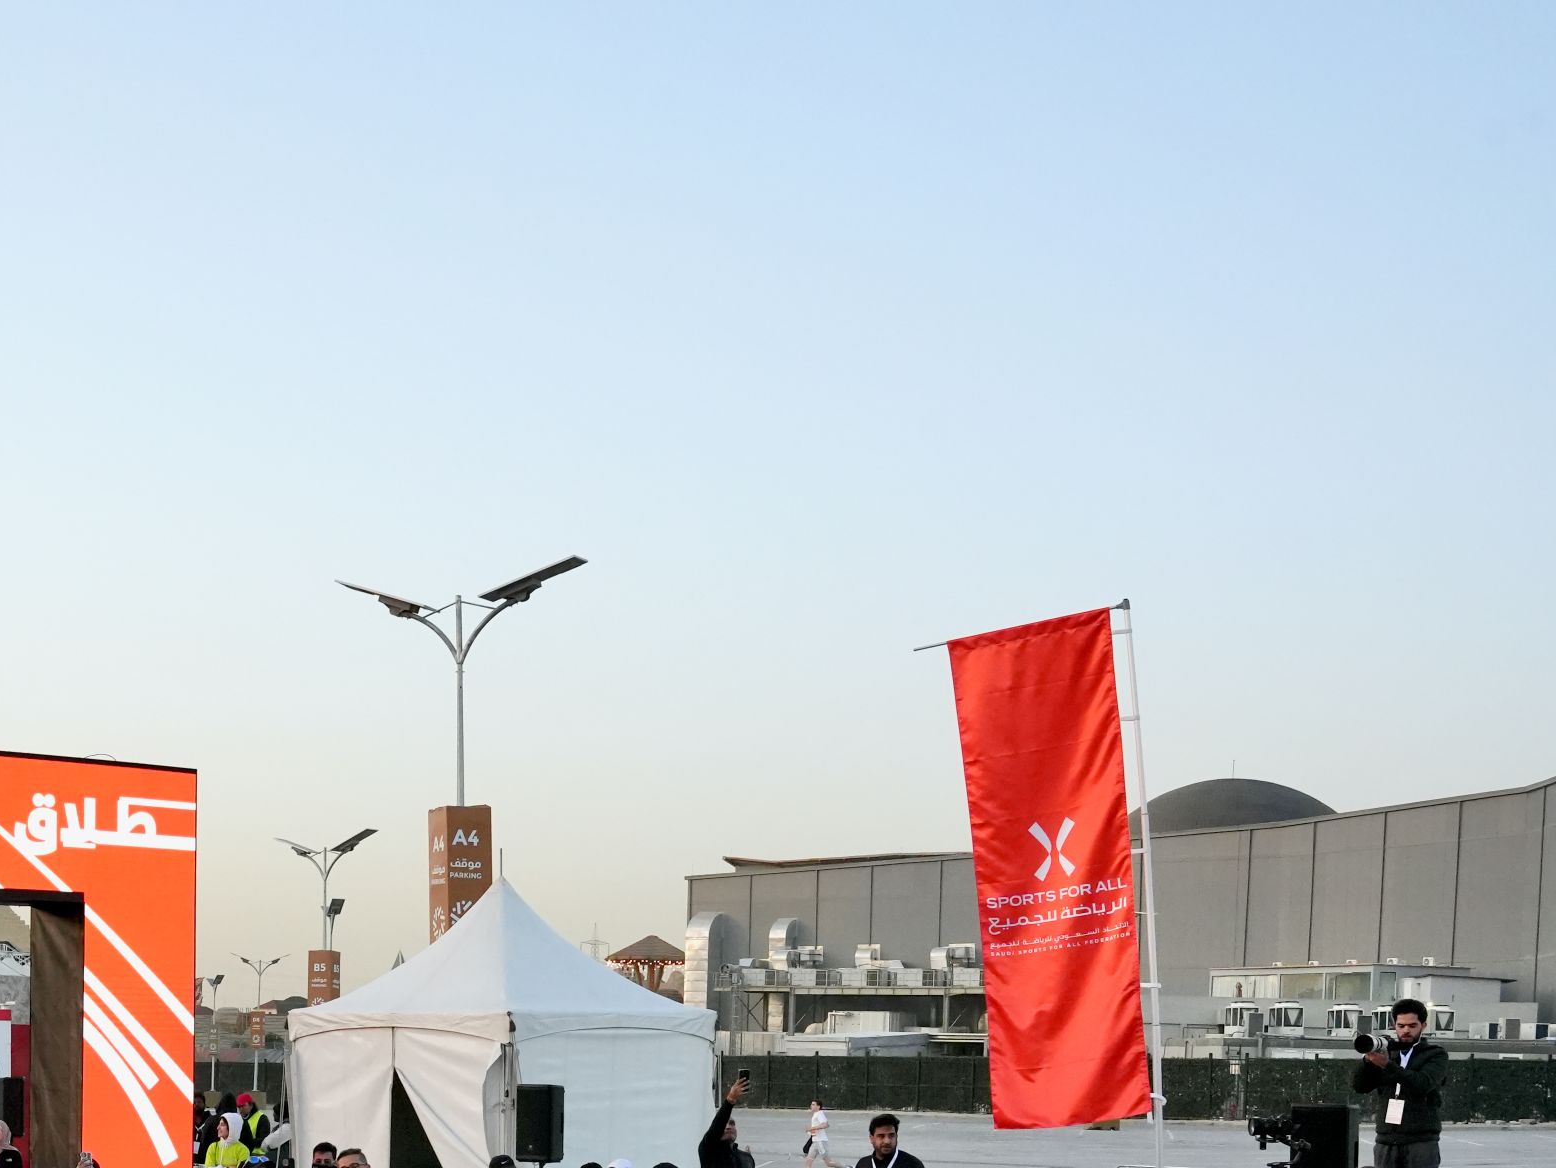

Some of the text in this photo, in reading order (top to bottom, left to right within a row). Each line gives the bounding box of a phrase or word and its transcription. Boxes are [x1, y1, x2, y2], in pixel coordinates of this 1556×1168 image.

[452, 829, 479, 847] A4
[450, 858, 482, 870] موقف
[449, 871, 482, 879] PARKING
[986, 877, 1128, 909] SPORTS FOR ALL
[988, 896, 1127, 935] الرياضة للجميع
[314, 963, 326, 972] B5
